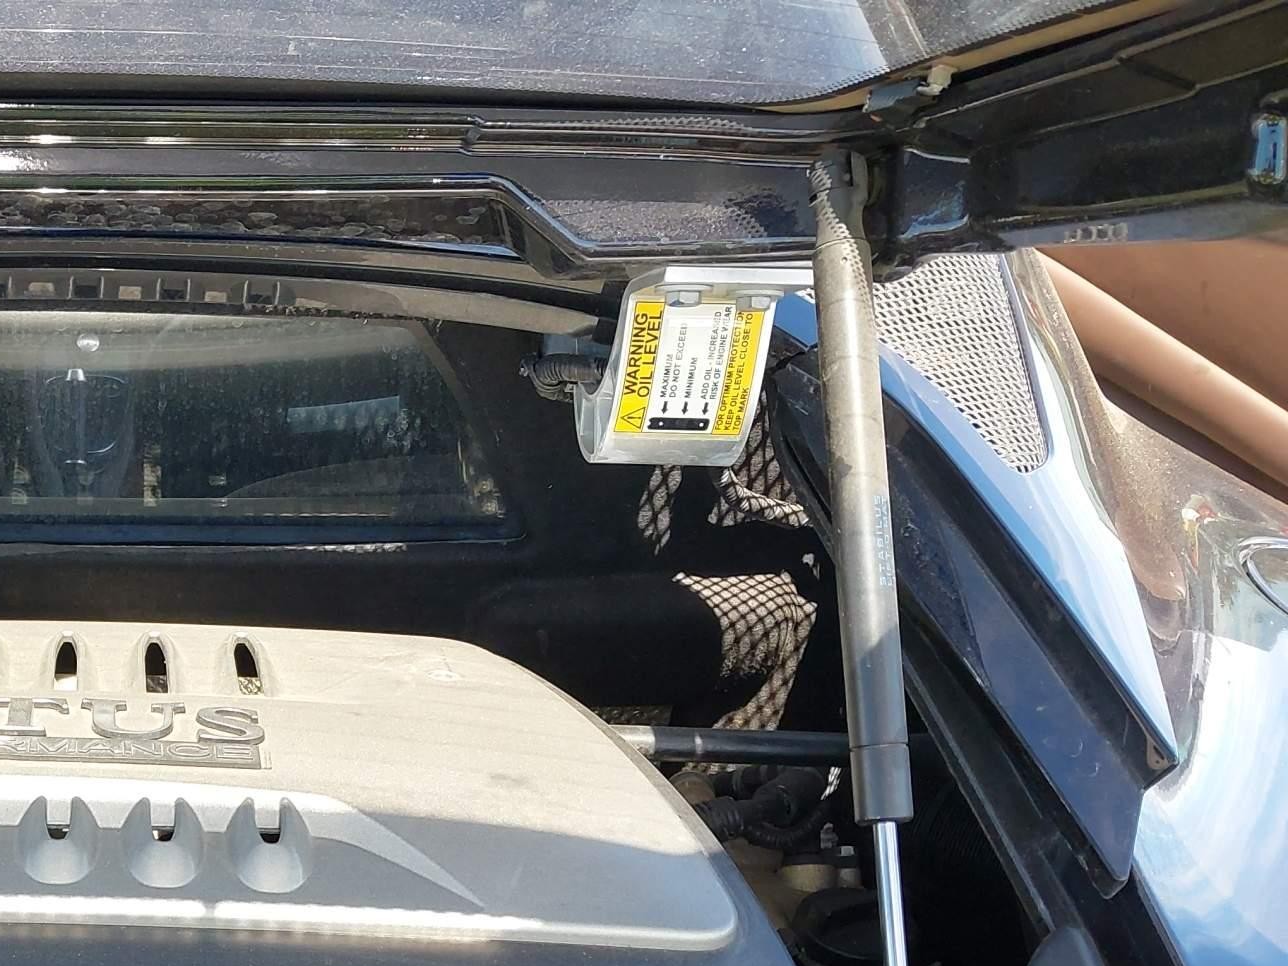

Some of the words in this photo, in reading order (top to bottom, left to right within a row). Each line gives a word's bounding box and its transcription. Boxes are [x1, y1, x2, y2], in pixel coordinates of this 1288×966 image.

[707, 311, 721, 360] INCREAED
[744, 313, 753, 326] TO
[642, 310, 662, 365] LEVEL
[675, 323, 688, 361] EXCEED
[715, 334, 727, 366] ENGINE
[739, 328, 751, 360] CLOSE
[623, 313, 648, 396] WARNING
[637, 370, 653, 398] OIL
[660, 354, 673, 398] MAXIMUM
[671, 362, 681, 383] NOT
[684, 357, 697, 399] MINIMUM
[703, 367, 712, 381] OIL
[713, 368, 721, 379] OF
[714, 414, 724, 431] FOR
[719, 370, 734, 412] OPTIMUM
[728, 311, 744, 369] PROTECTION
[733, 362, 745, 390] LEVEL
[669, 384, 678, 398] DO
[700, 382, 710, 400] ADD
[709, 381, 719, 400] RISK
[729, 392, 739, 407] OIL
[724, 409, 734, 430] KEEP
[732, 415, 741, 431] TOP
[737, 387, 749, 412] MARK
[873, 495, 887, 586] STABILUS
[881, 496, 893, 586] LIFT-OMAT
